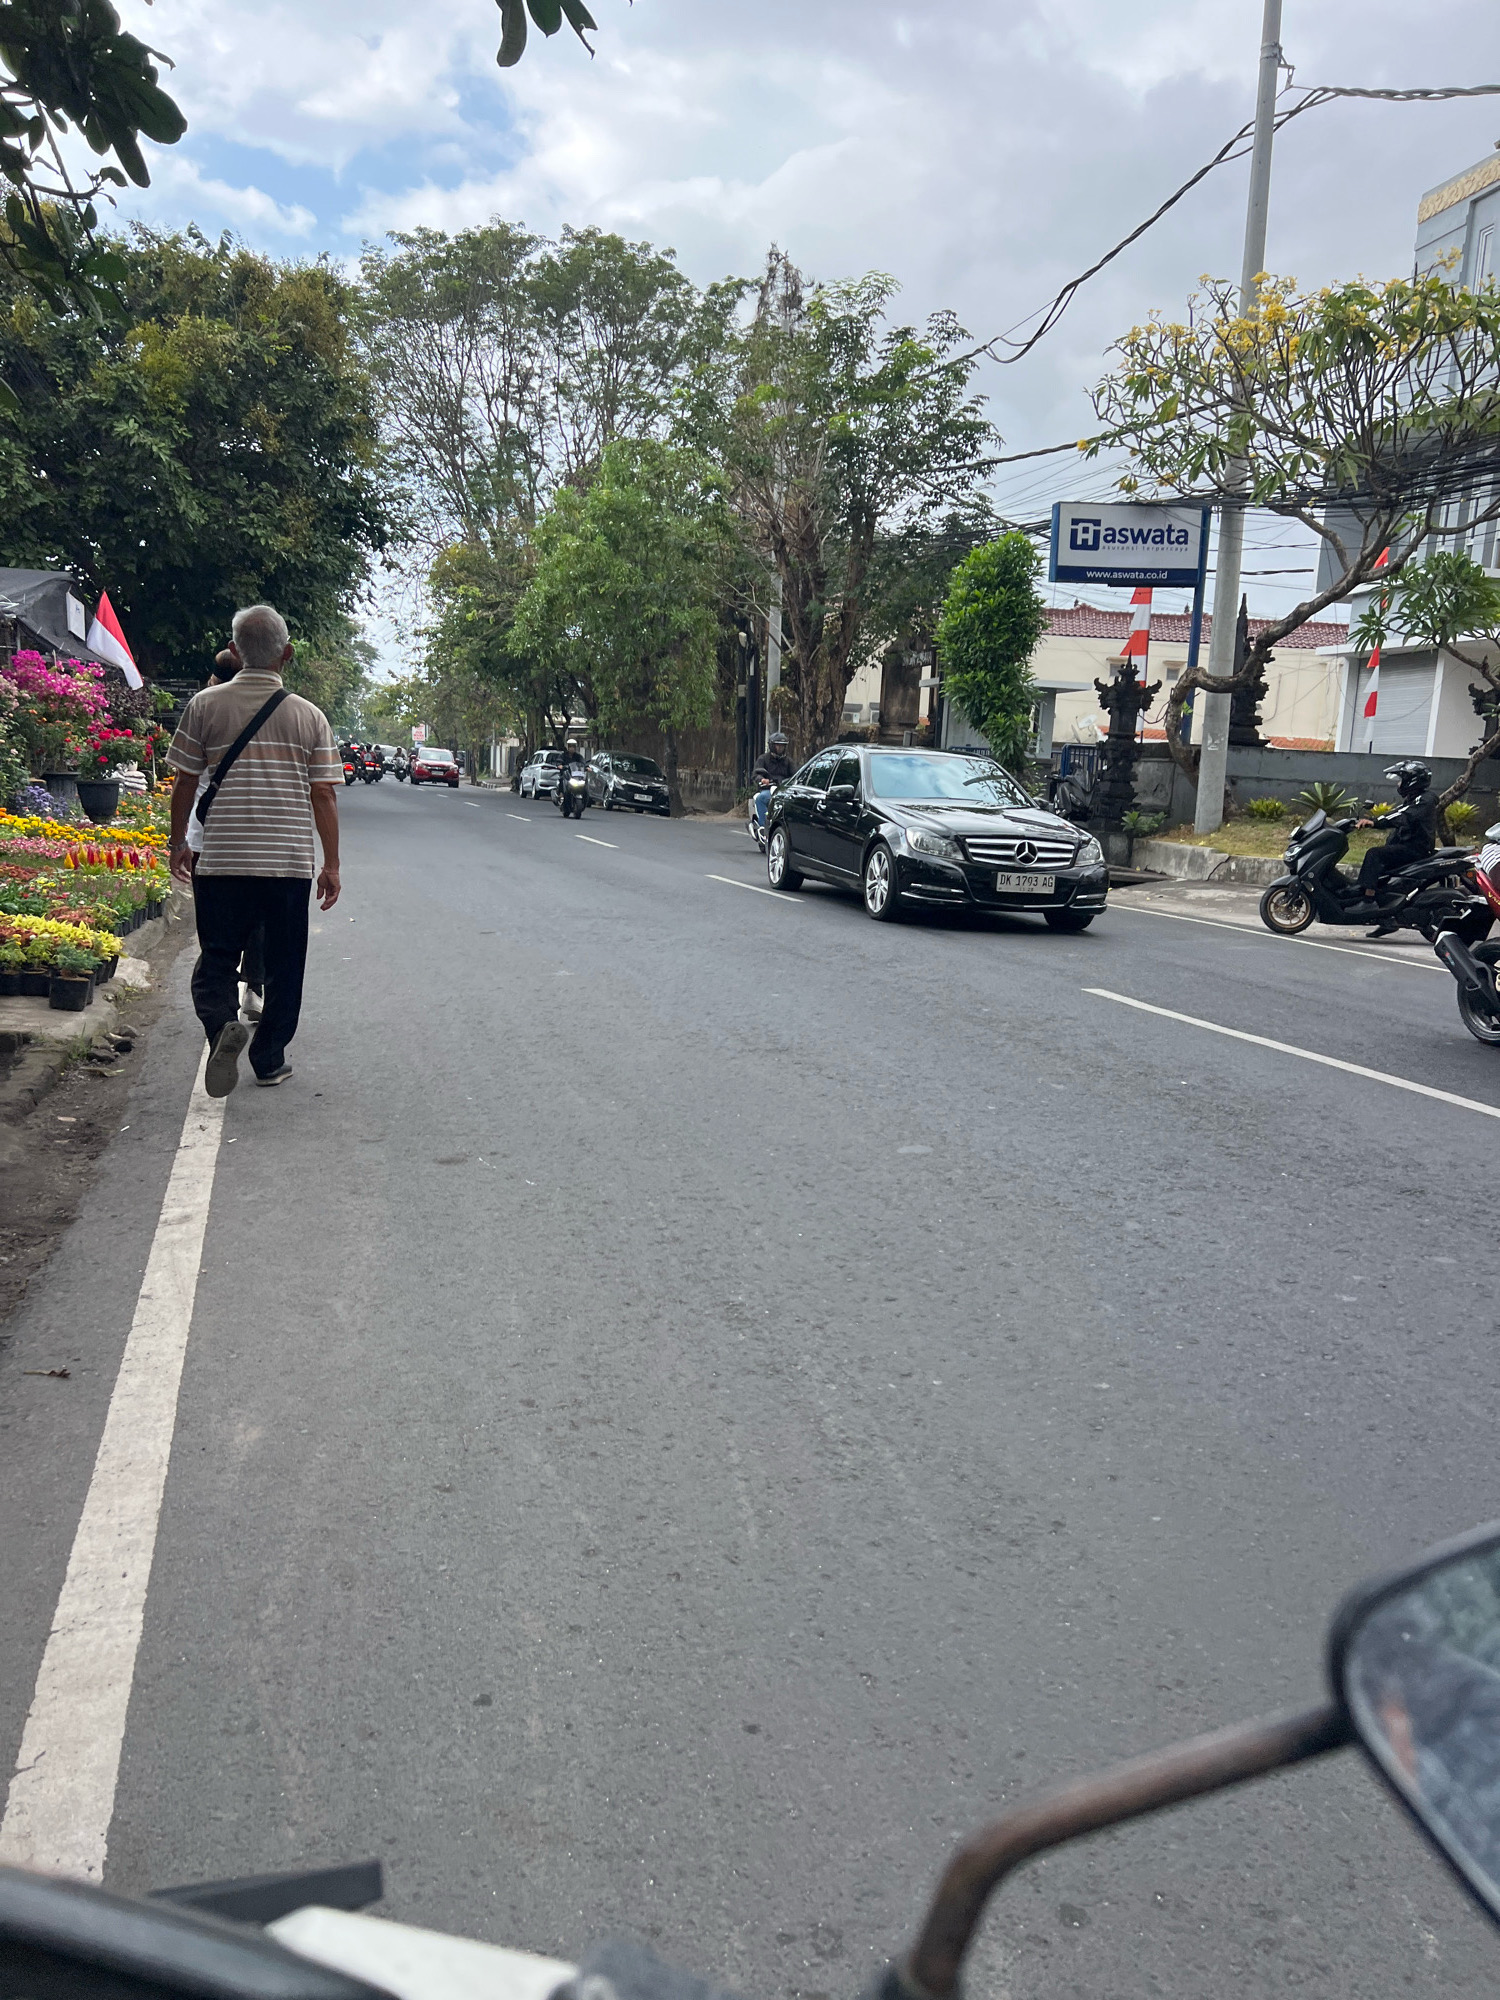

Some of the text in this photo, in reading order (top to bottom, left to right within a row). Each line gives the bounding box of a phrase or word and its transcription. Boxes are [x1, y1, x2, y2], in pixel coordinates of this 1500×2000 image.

[1103, 524, 1189, 545] aswata
[1086, 569, 1168, 579] www.aswata.co.id
[1000, 874, 1054, 887] DK 1793 AG
